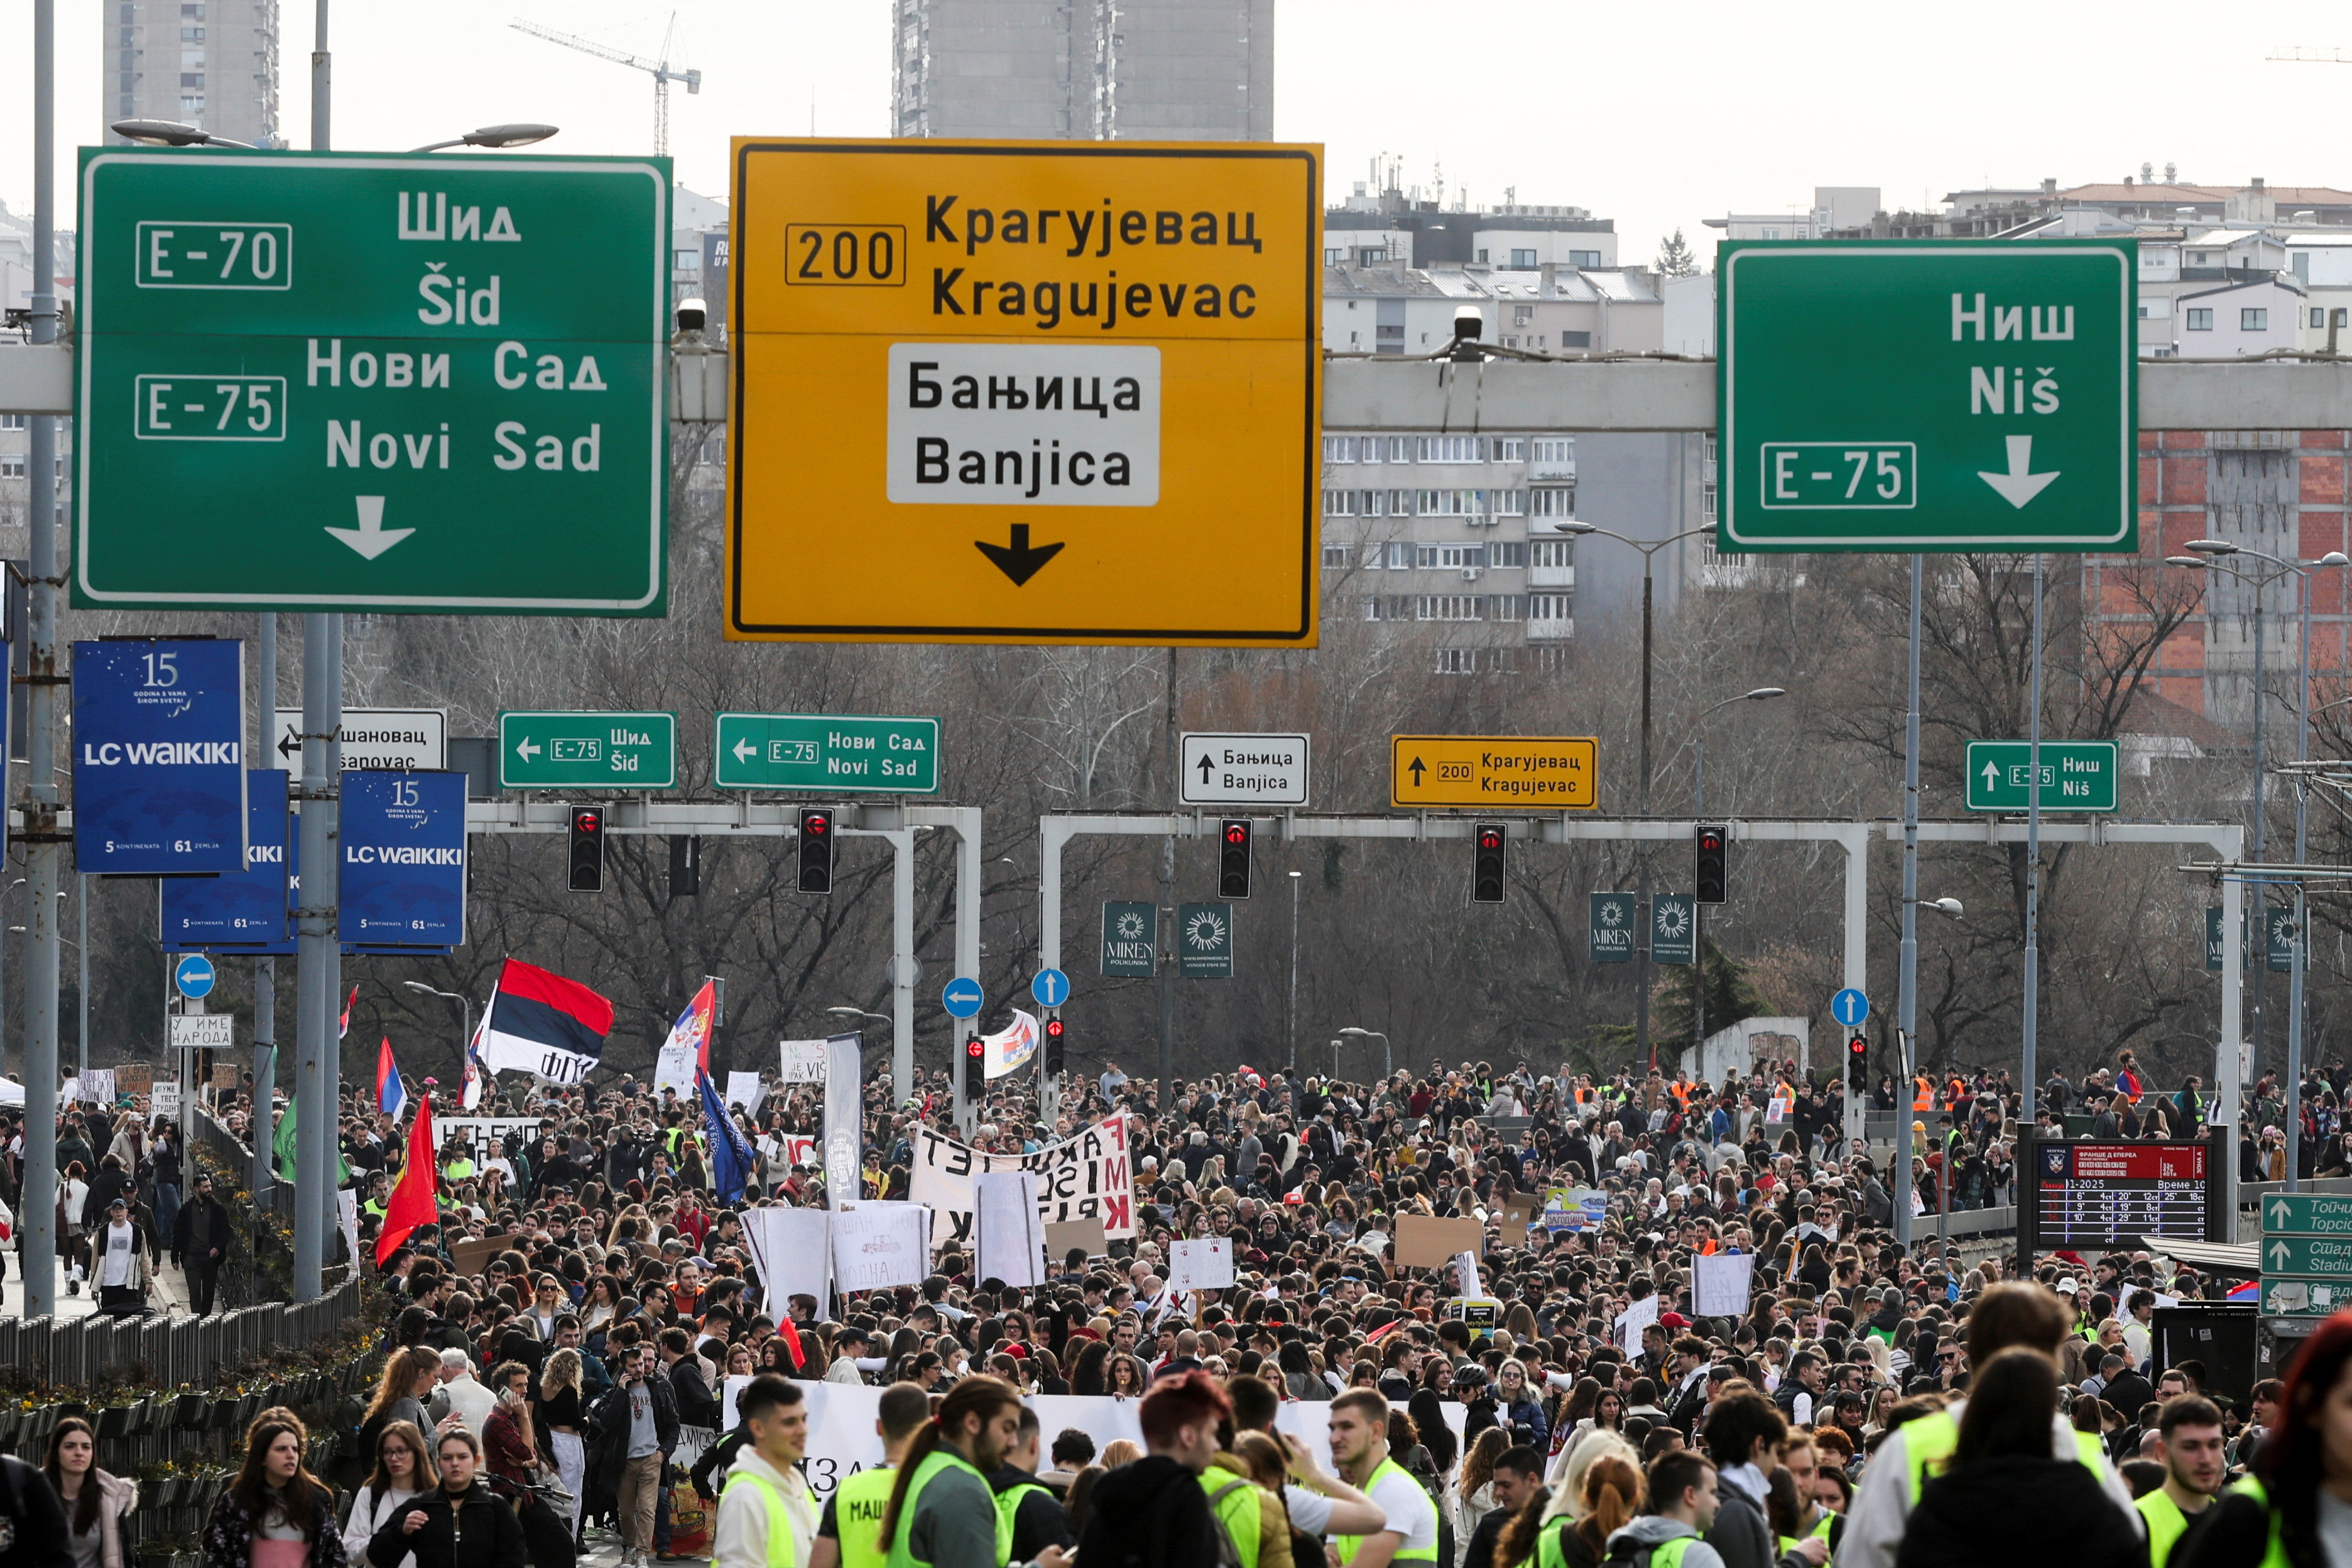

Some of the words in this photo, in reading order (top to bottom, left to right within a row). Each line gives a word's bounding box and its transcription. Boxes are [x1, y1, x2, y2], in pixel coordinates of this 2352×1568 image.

[398, 192, 521, 242] Шид
[927, 196, 1262, 257] Крагујевац
[799, 230, 893, 280] 200
[418, 261, 499, 326] Šid
[933, 268, 1256, 329] Kragujevac
[1951, 293, 2074, 341] Ниш
[308, 338, 450, 388] Нови
[494, 340, 607, 391] Сад
[909, 362, 1140, 418] Бањица
[1971, 366, 2060, 415] Niš
[327, 420, 449, 469] Novi
[493, 421, 601, 472] Sad
[916, 437, 1130, 498] Banjica
[141, 651, 178, 687] 15
[342, 731, 426, 745] шановац
[611, 729, 651, 745] Шид
[829, 732, 875, 749] Нови
[888, 734, 925, 751] Сад
[85, 743, 121, 765] LC
[611, 750, 638, 771] Šid
[1224, 749, 1293, 766] Бањица
[1482, 753, 1581, 772] Крагујевац
[828, 758, 868, 775] Novi
[881, 759, 917, 776] Sad
[1442, 765, 1469, 779] 200
[2063, 757, 2099, 773] Ниш
[1224, 774, 1287, 792] Banjica
[2013, 768, 2050, 783] E-5
[393, 781, 419, 806] 15
[1481, 777, 1576, 796] Kragujevac
[2063, 781, 2089, 795] Niš
[106, 841, 114, 852] 5
[174, 841, 192, 852] 61
[347, 846, 374, 863] LC
[183, 919, 189, 928] 5
[234, 919, 248, 928] 61
[361, 919, 367, 928] 5
[412, 920, 425, 929] 61
[1594, 929, 1631, 944] MIREN
[1108, 942, 1153, 959] MIREN
[173, 1018, 182, 1030] У
[197, 1018, 227, 1030] ИМЕ
[173, 1032, 229, 1044] НАРОДА
[2067, 1179, 2104, 1189] 1-2025
[2158, 1180, 2190, 1190] Време
[2310, 1242, 2352, 1256] Стад
